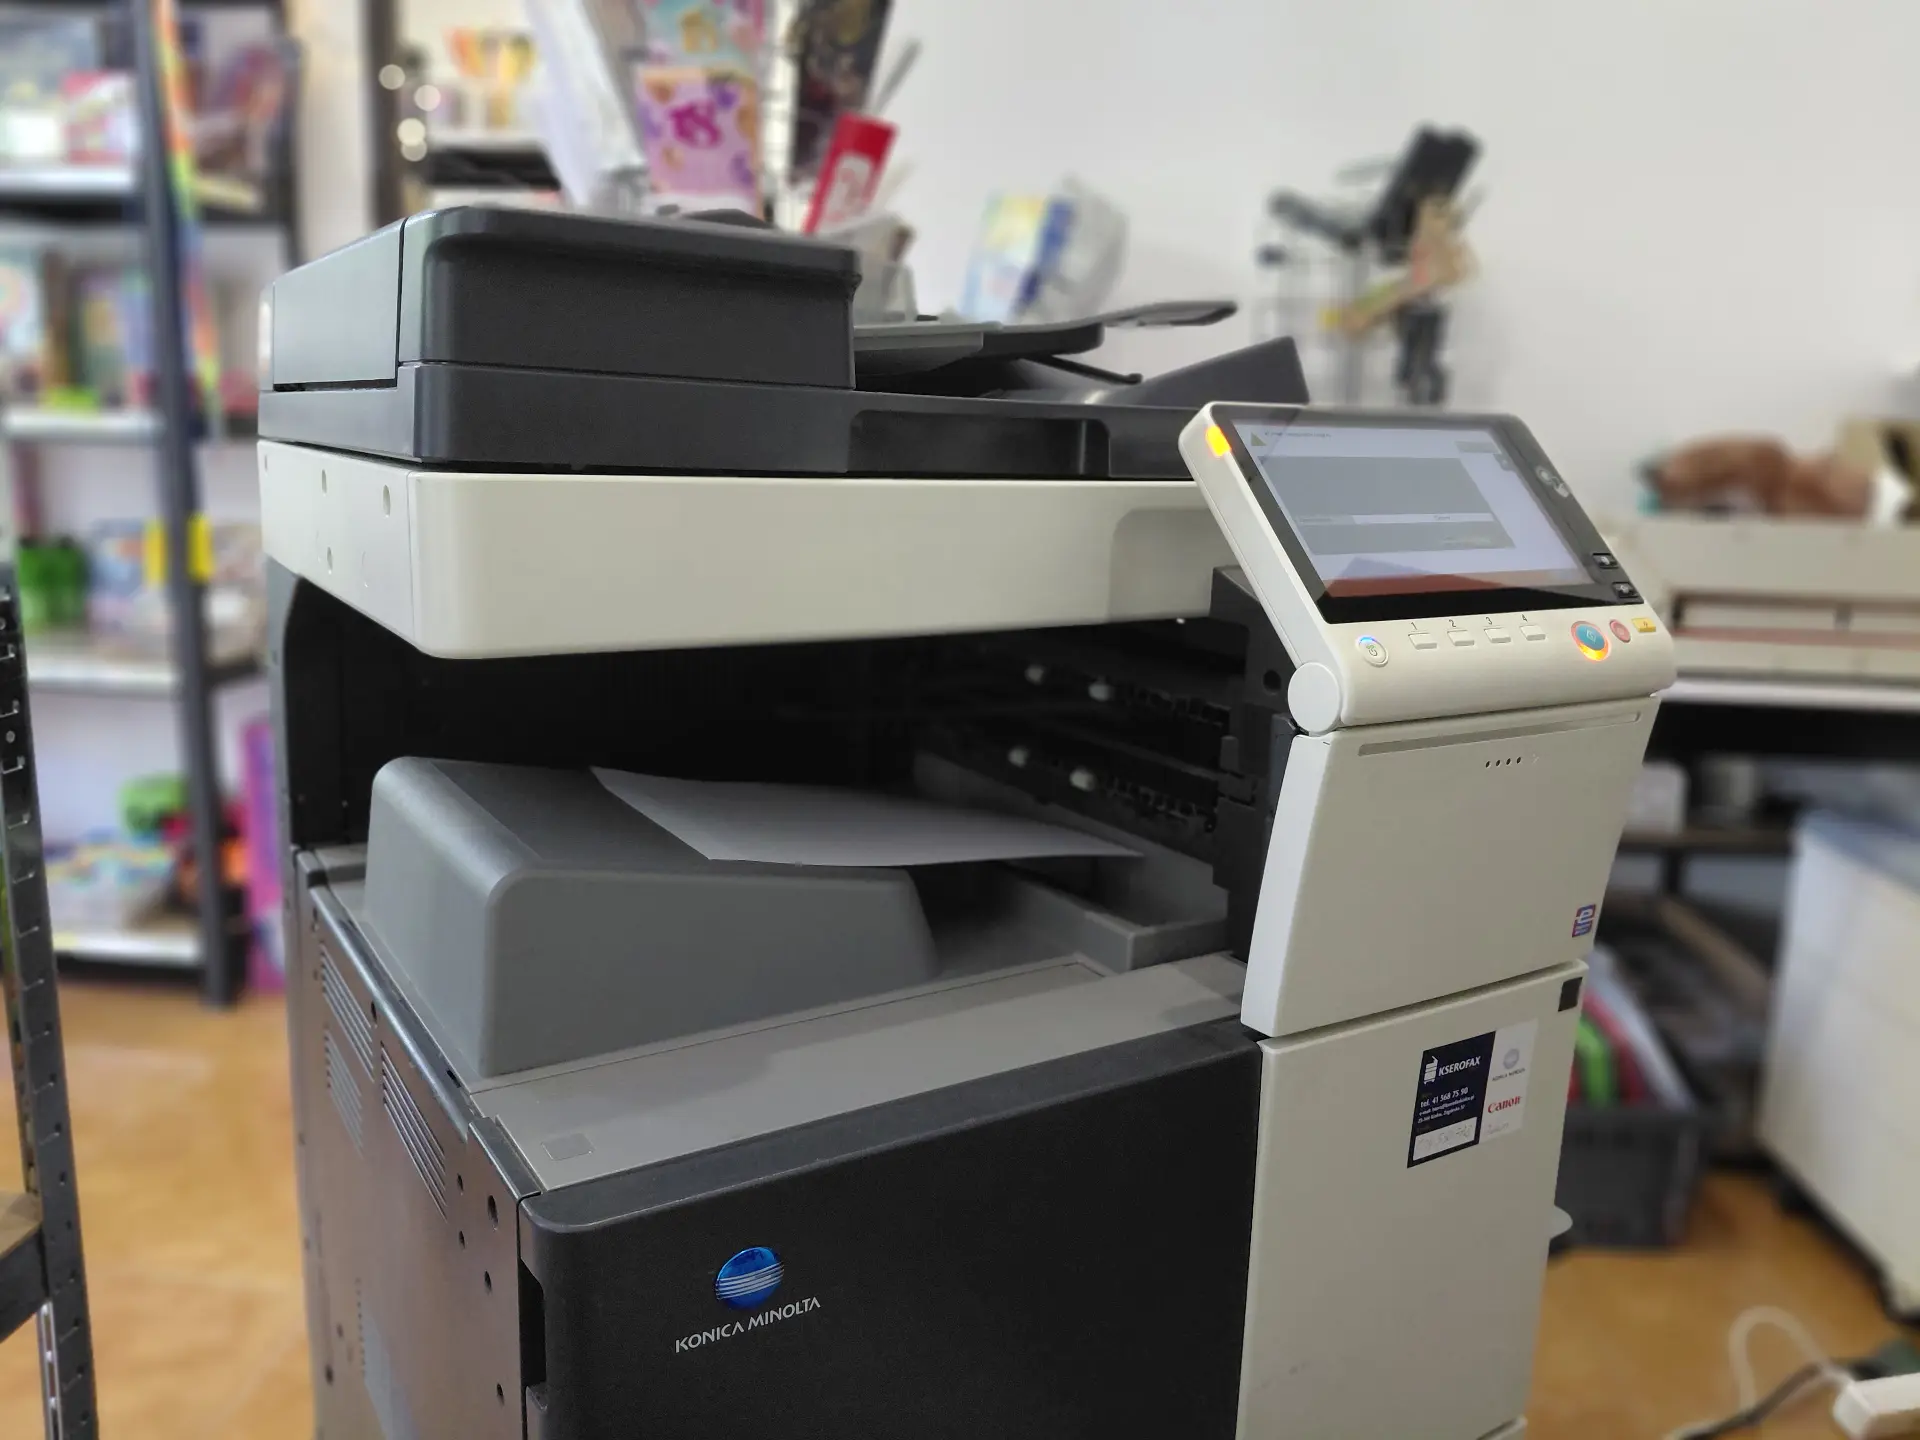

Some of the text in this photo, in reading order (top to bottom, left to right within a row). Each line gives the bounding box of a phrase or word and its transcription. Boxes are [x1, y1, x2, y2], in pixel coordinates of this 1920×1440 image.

[1411, 614, 1528, 630] 1 2 3 4
[1439, 1056, 1481, 1076] KSEROFAX
[1420, 1099, 1430, 1108] tel.
[1432, 1096, 1439, 1104] 41
[1487, 1096, 1521, 1113] Canon
[675, 1296, 822, 1354] KONICA MINOLTA
